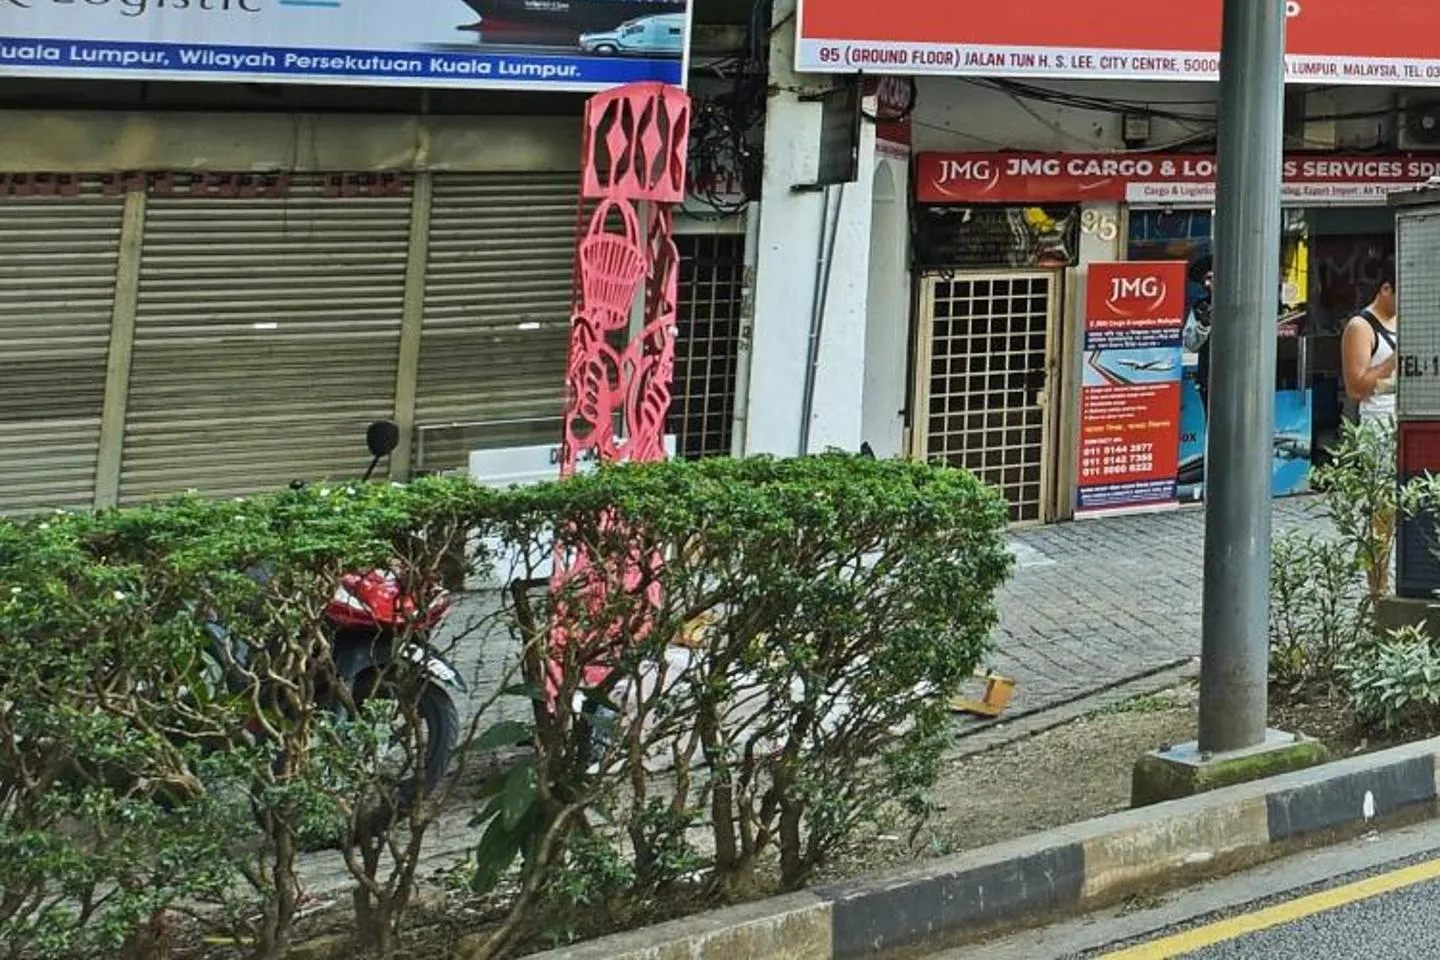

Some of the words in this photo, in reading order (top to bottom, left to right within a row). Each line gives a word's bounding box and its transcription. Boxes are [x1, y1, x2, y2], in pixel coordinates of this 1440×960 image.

[0, 43, 60, 60] uala
[70, 45, 170, 67] Lumpur,
[180, 48, 276, 70] Wilayah
[284, 53, 421, 72] Persekutuan
[429, 59, 491, 74] Kuala
[499, 61, 582, 79] Lumpur.
[819, 47, 842, 61] 95
[846, 44, 908, 66] (GROUND
[911, 47, 961, 69] FLOOR)
[965, 49, 1005, 66] JALAN
[1010, 51, 1035, 67] TUN
[1038, 53, 1052, 68] H.
[1056, 54, 1068, 68] S.
[1100, 55, 1128, 70] CITY
[1132, 56, 1181, 74] CENTRE,
[1291, 60, 1338, 77] LUMPUR,
[1343, 62, 1400, 79] MALAYSIA,
[1404, 64, 1425, 77] TEL:
[939, 160, 990, 183] JMG
[1005, 159, 1060, 176] JMG
[1067, 159, 1153, 177] CARGO
[1159, 160, 1177, 176] &
[1303, 161, 1402, 177] SERVICES
[1111, 276, 1158, 302] JMG
